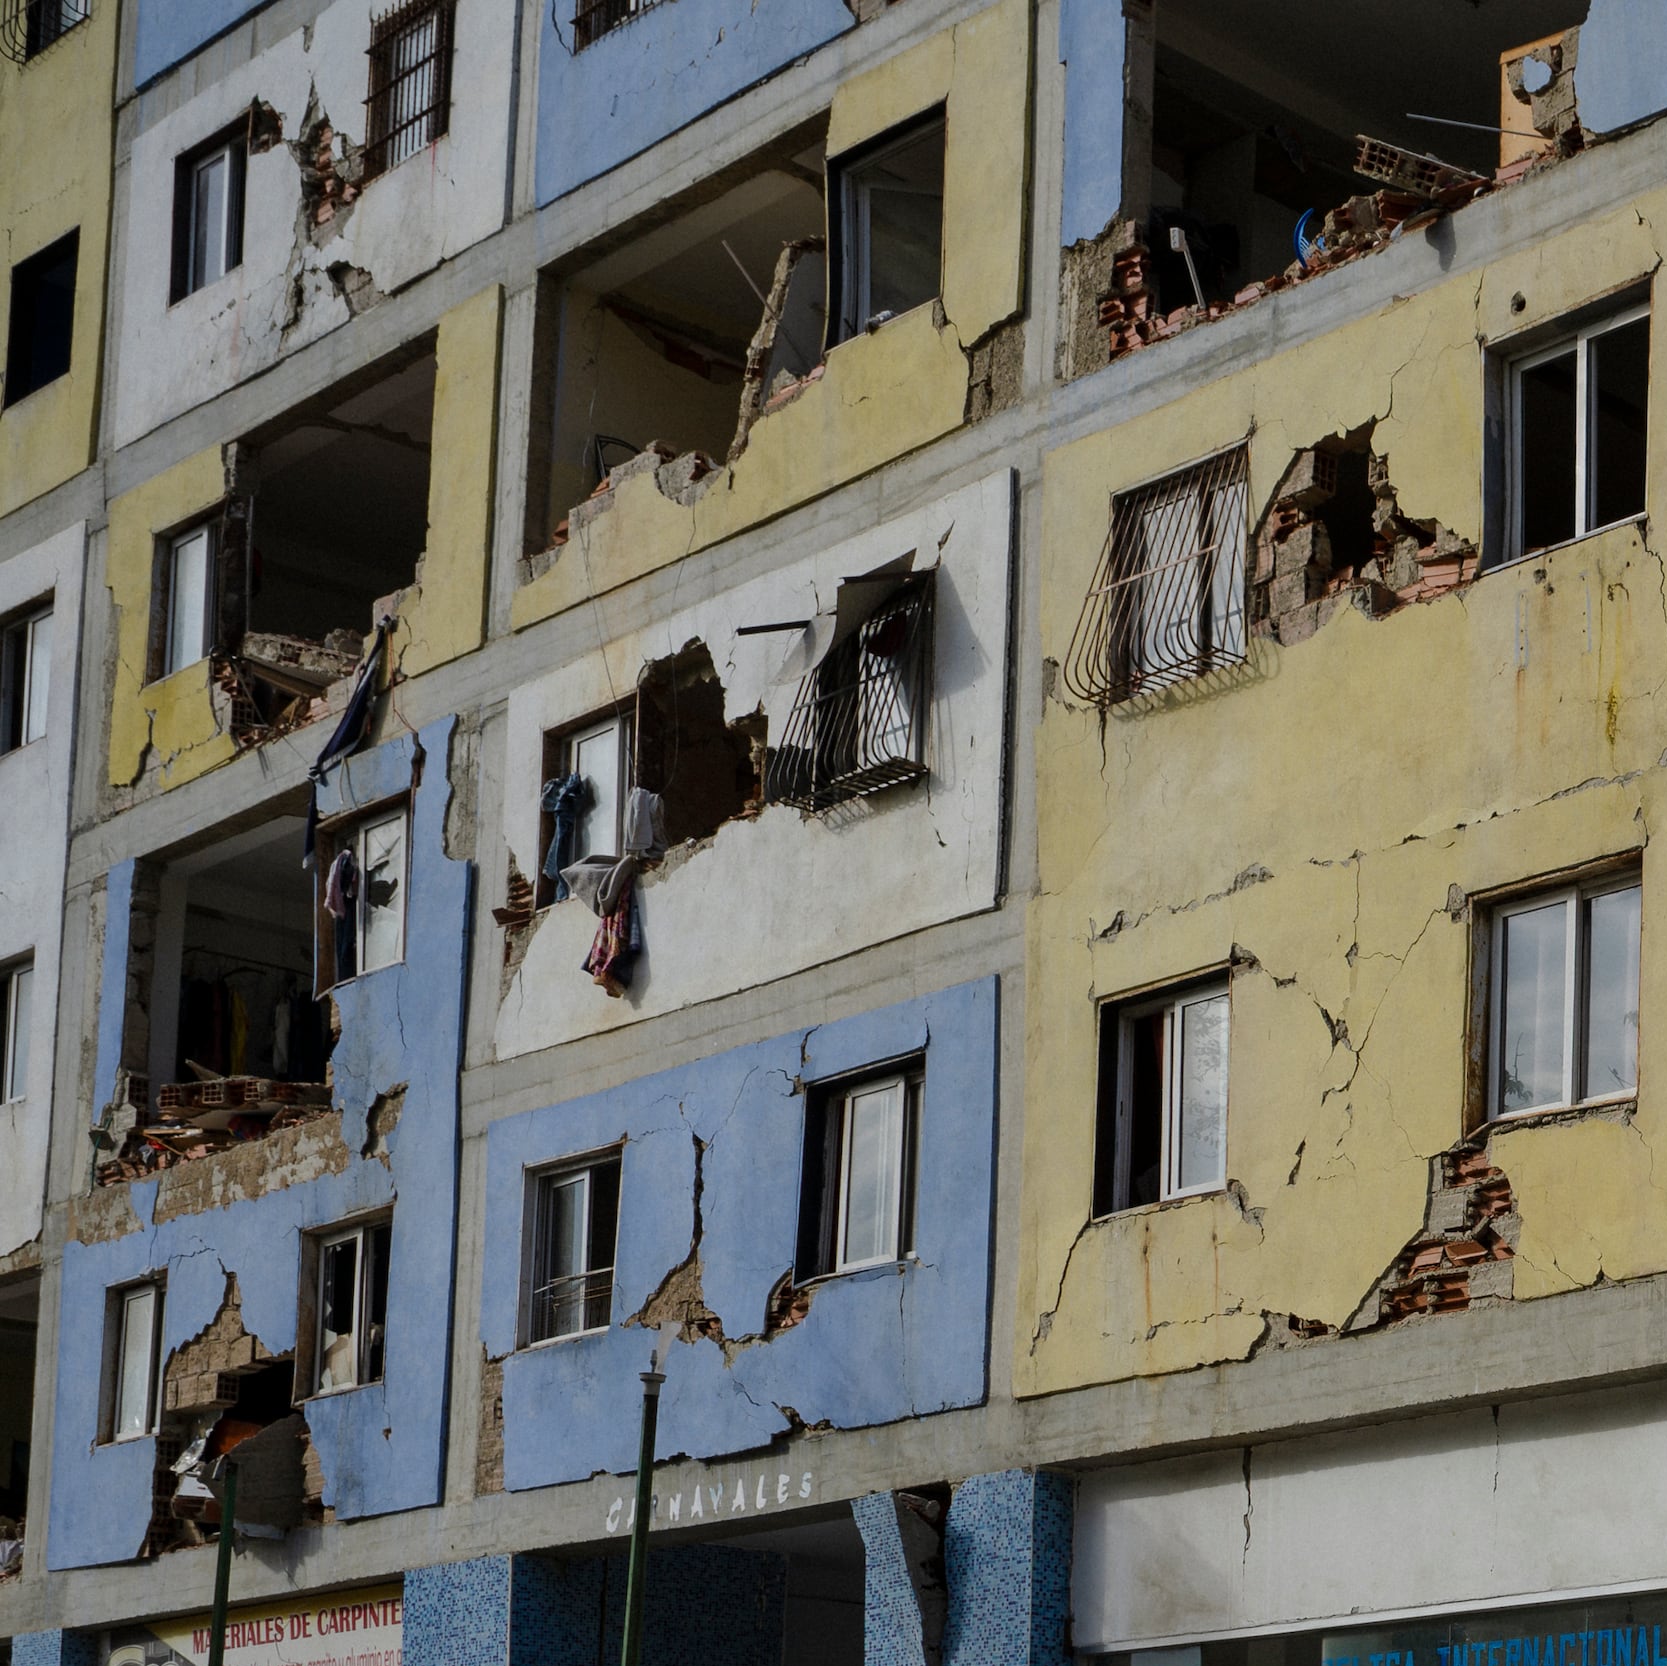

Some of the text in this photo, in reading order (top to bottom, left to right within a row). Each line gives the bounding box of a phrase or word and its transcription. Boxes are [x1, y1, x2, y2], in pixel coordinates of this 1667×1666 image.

[193, 1599, 404, 1654] MAERIALES DE CARPINTE
